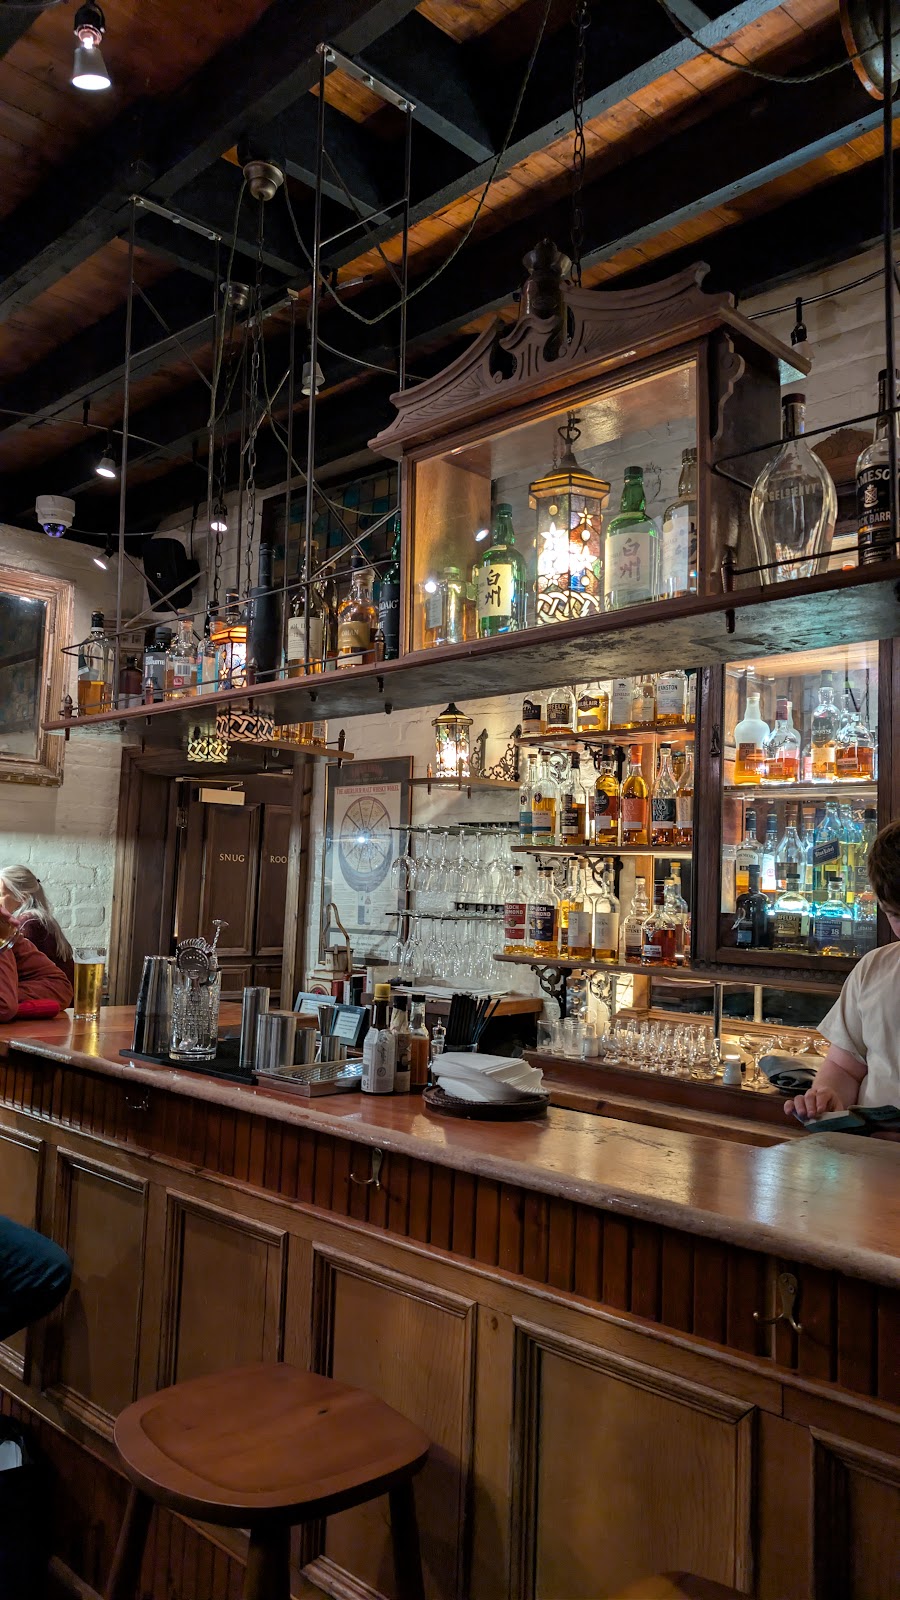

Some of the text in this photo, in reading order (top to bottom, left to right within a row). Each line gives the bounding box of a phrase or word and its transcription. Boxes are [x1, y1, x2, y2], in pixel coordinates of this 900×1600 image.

[869, 511, 892, 524] BARR
[619, 537, 641, 582] 白州
[485, 569, 502, 608] 白州
[219, 853, 288, 864] SNUG ROO
